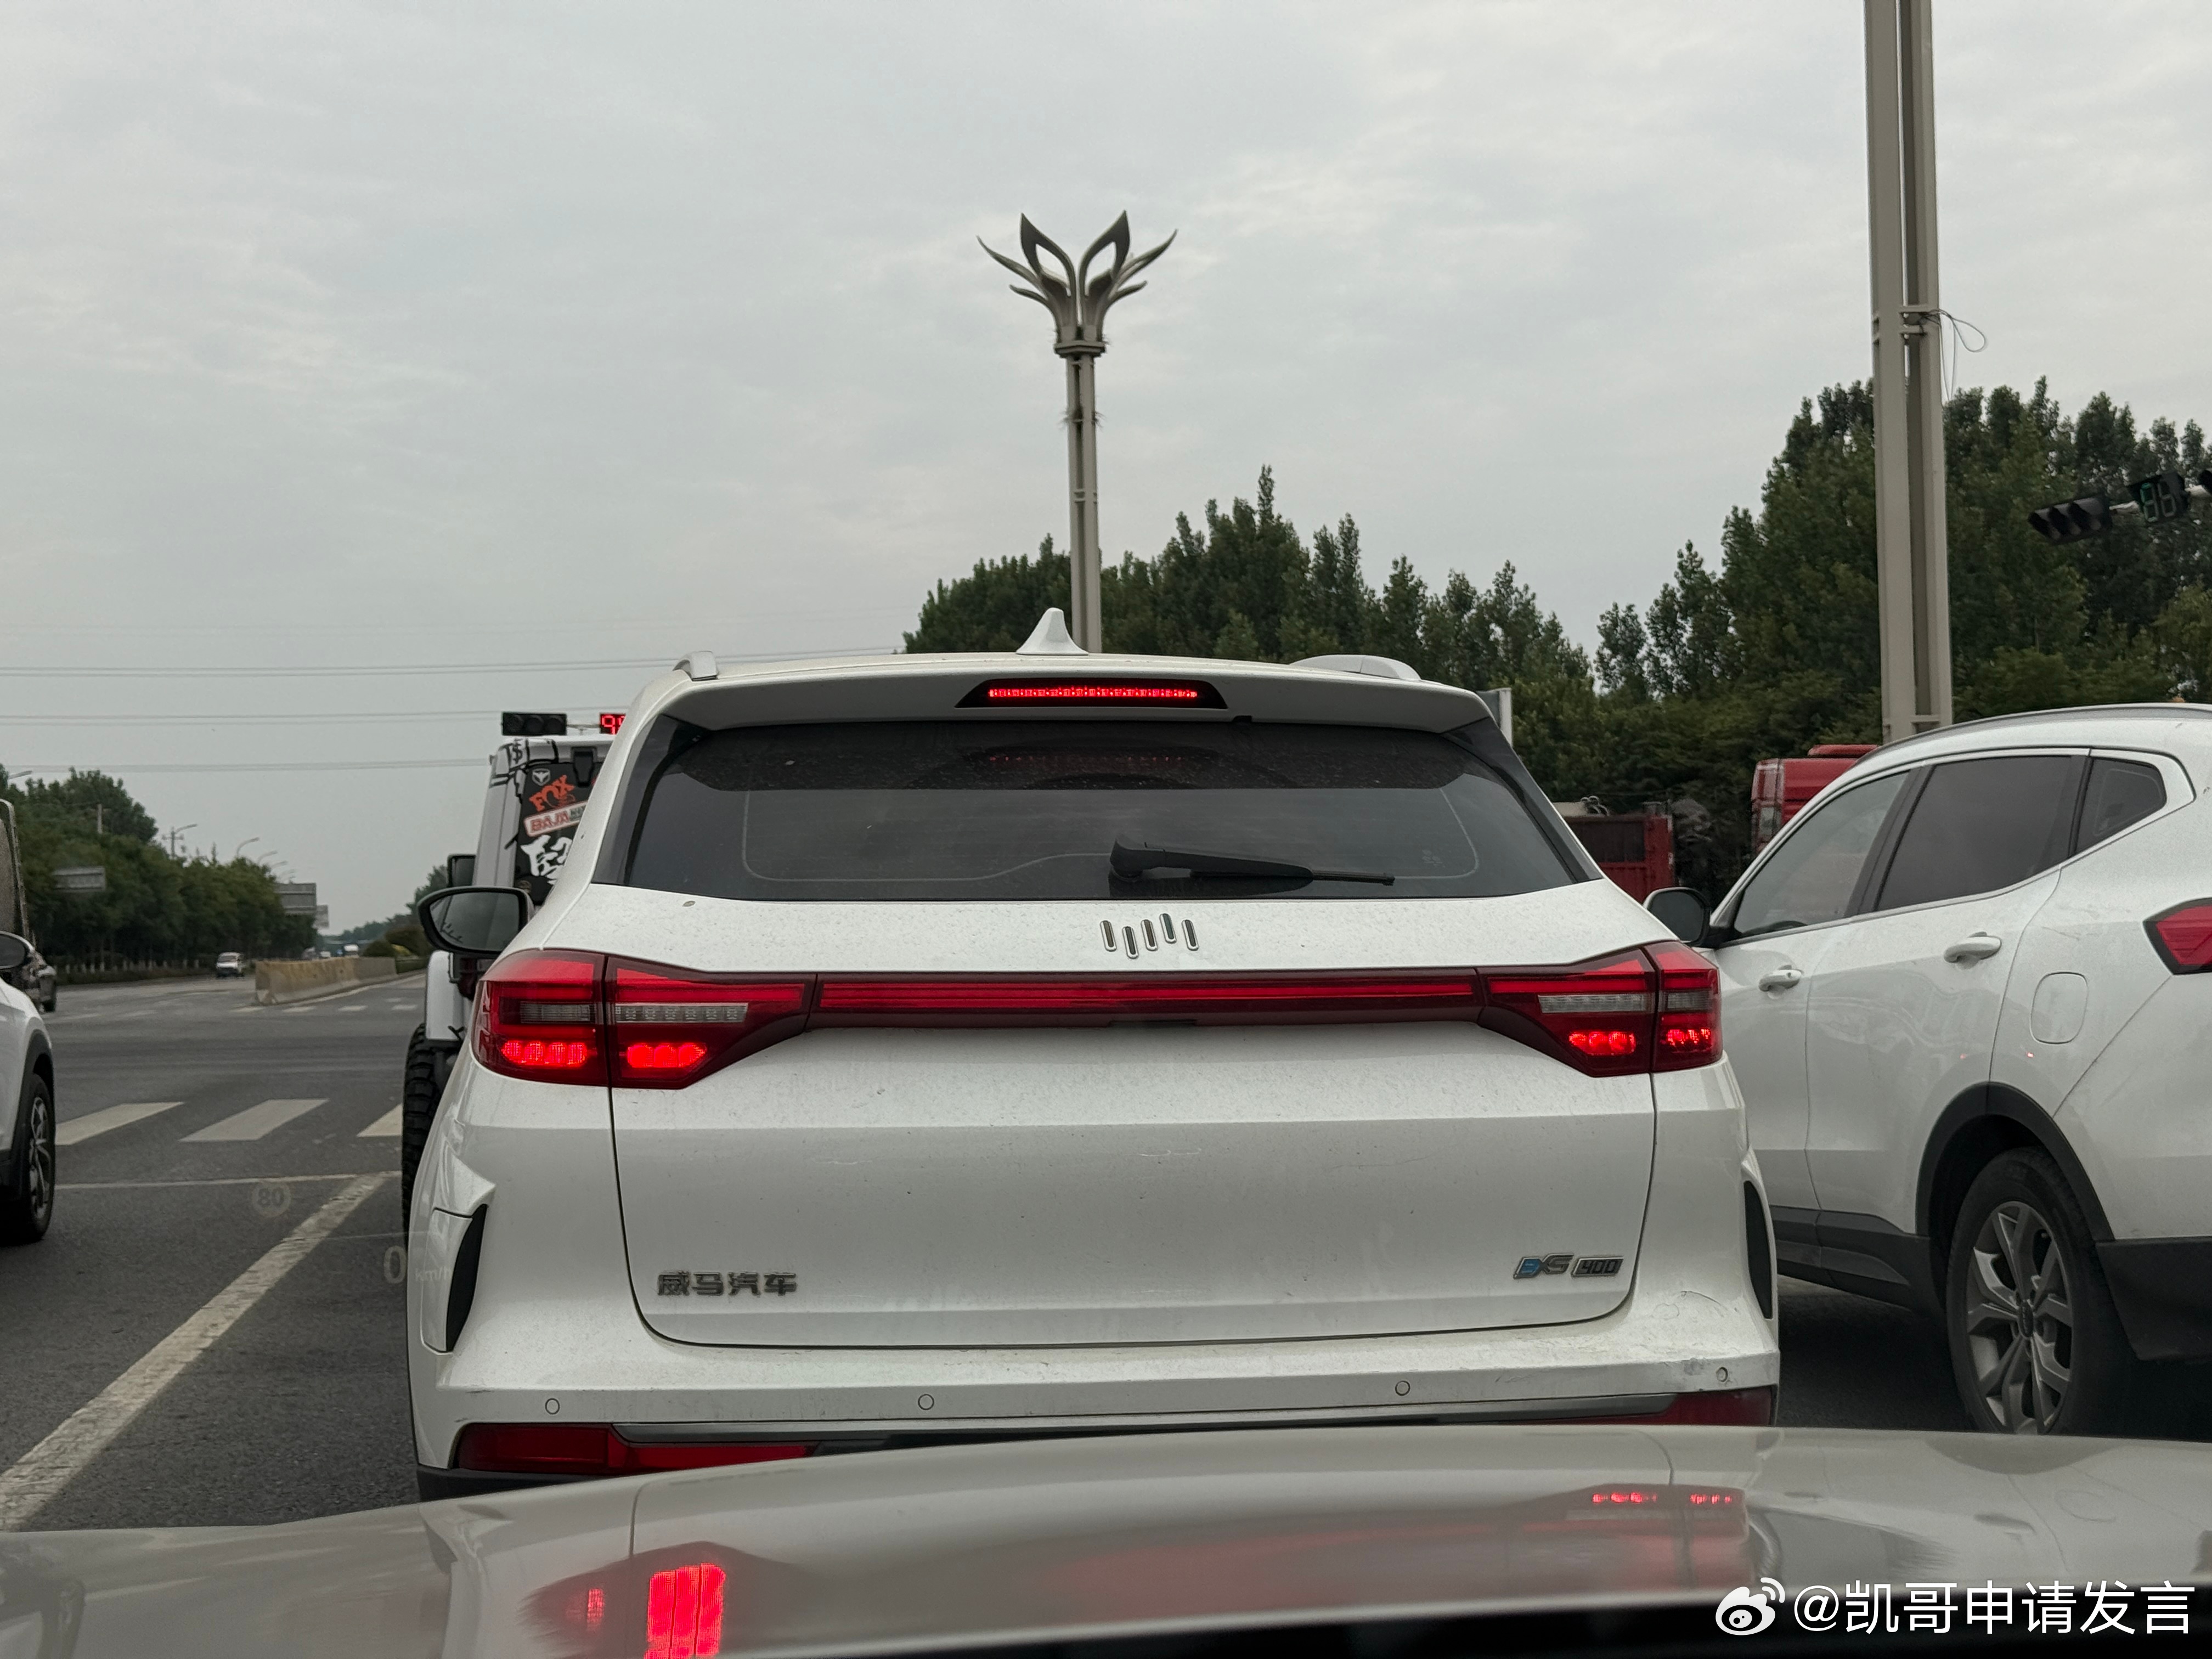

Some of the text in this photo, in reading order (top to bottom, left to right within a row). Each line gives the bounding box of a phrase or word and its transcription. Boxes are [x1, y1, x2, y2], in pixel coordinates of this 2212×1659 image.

[529, 774, 575, 812] FOX
[530, 810, 570, 832] BAJA
[257, 1188, 284, 1209] 80
[1574, 1257, 1622, 1276] 400
[657, 1269, 798, 1297] 威马汽车
